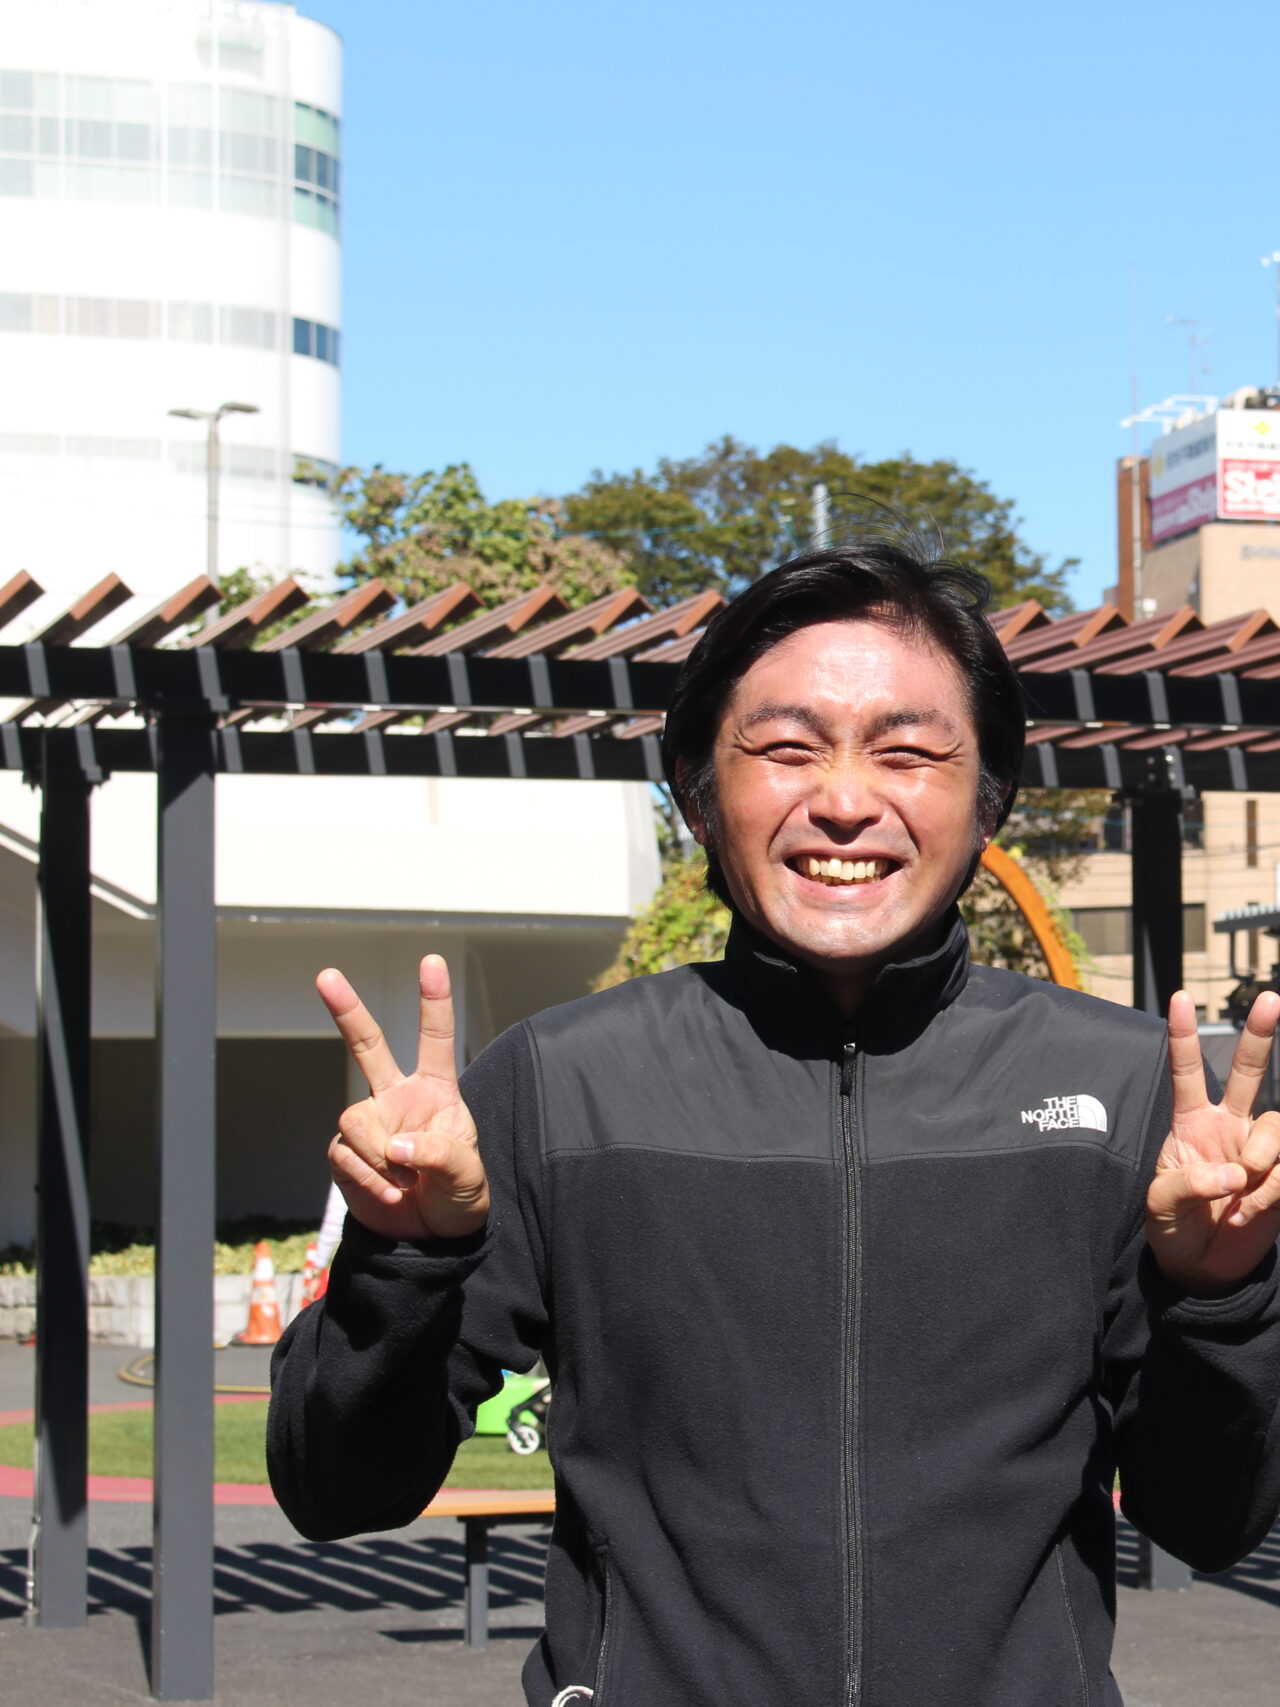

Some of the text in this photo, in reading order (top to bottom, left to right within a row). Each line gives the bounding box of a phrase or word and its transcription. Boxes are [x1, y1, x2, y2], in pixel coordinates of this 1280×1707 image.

[1043, 1096, 1077, 1109] THE
[1020, 1105, 1078, 1123] NORTH
[1039, 1118, 1080, 1132] FACE
